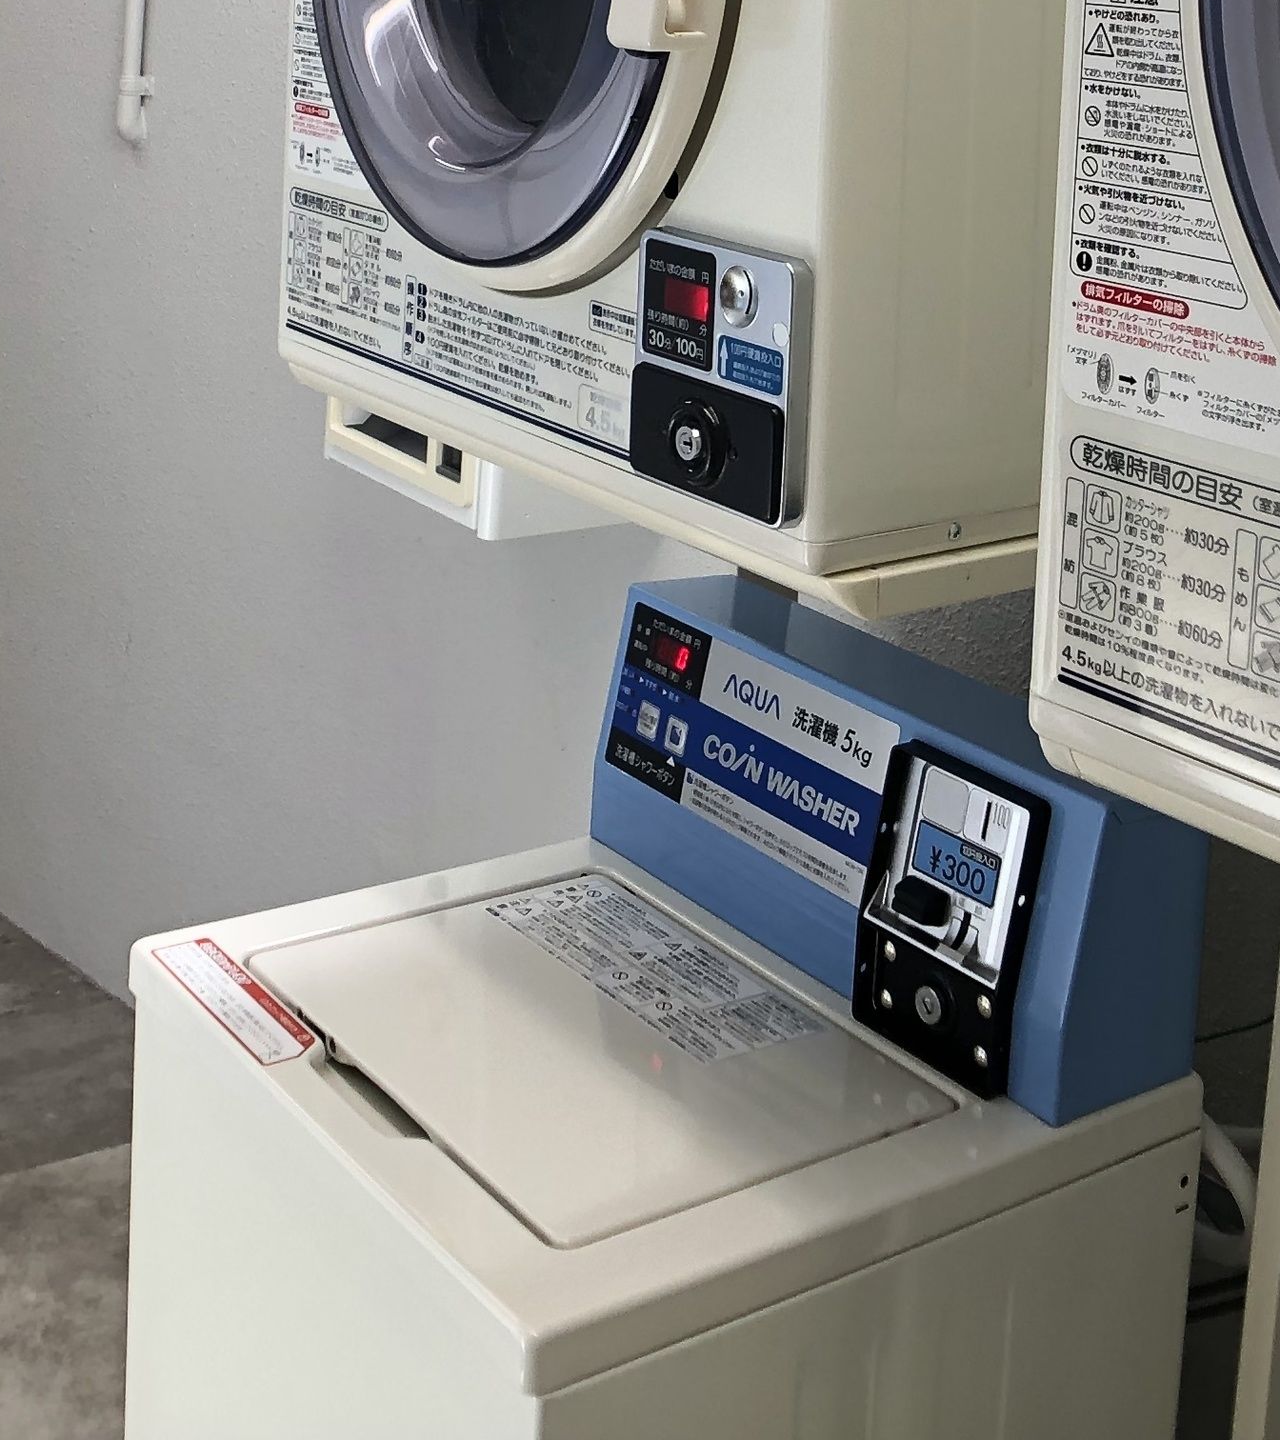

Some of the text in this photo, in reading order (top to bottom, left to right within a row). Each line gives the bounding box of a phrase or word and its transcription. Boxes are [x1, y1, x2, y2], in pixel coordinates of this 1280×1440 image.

[1084, 283, 1186, 317] 排気フィルターの掃除
[1082, 442, 1243, 511] 乾燥時間の目安
[1123, 540, 1168, 566] ブラウス
[723, 672, 873, 769] AQUA 洗濯機 5kg
[766, 766, 861, 837] WASHER
[929, 846, 986, 895] ¥300
